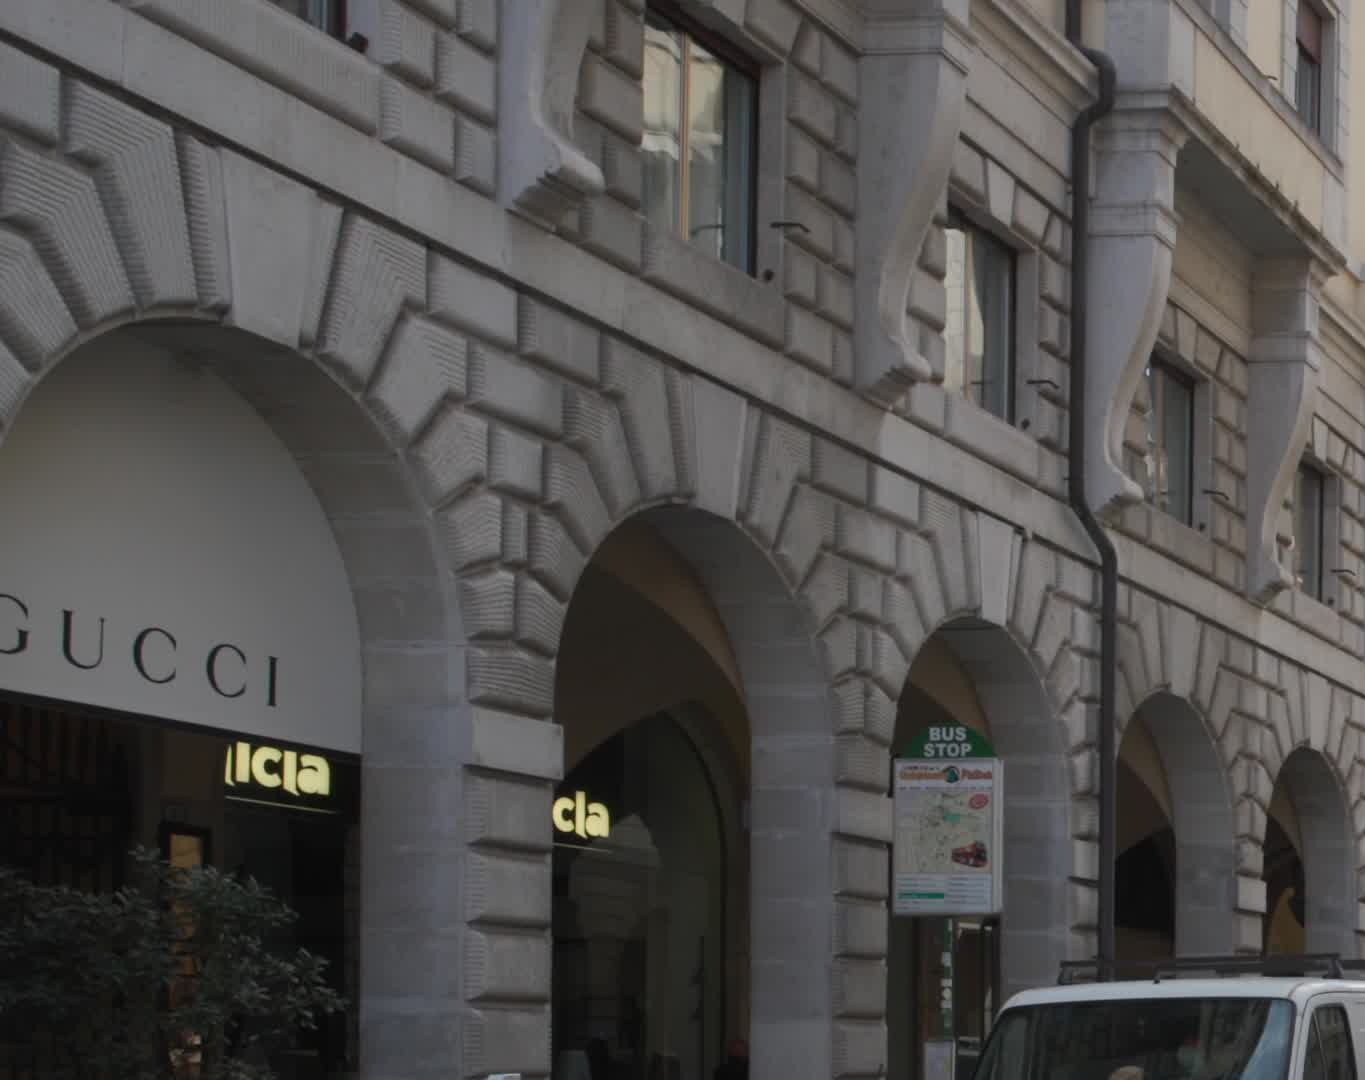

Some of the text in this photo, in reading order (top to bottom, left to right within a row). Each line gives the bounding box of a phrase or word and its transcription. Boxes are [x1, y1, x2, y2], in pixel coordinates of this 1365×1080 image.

[0, 593, 278, 707] GUCCI
[929, 727, 967, 741] BUS
[923, 743, 972, 757] STOP
